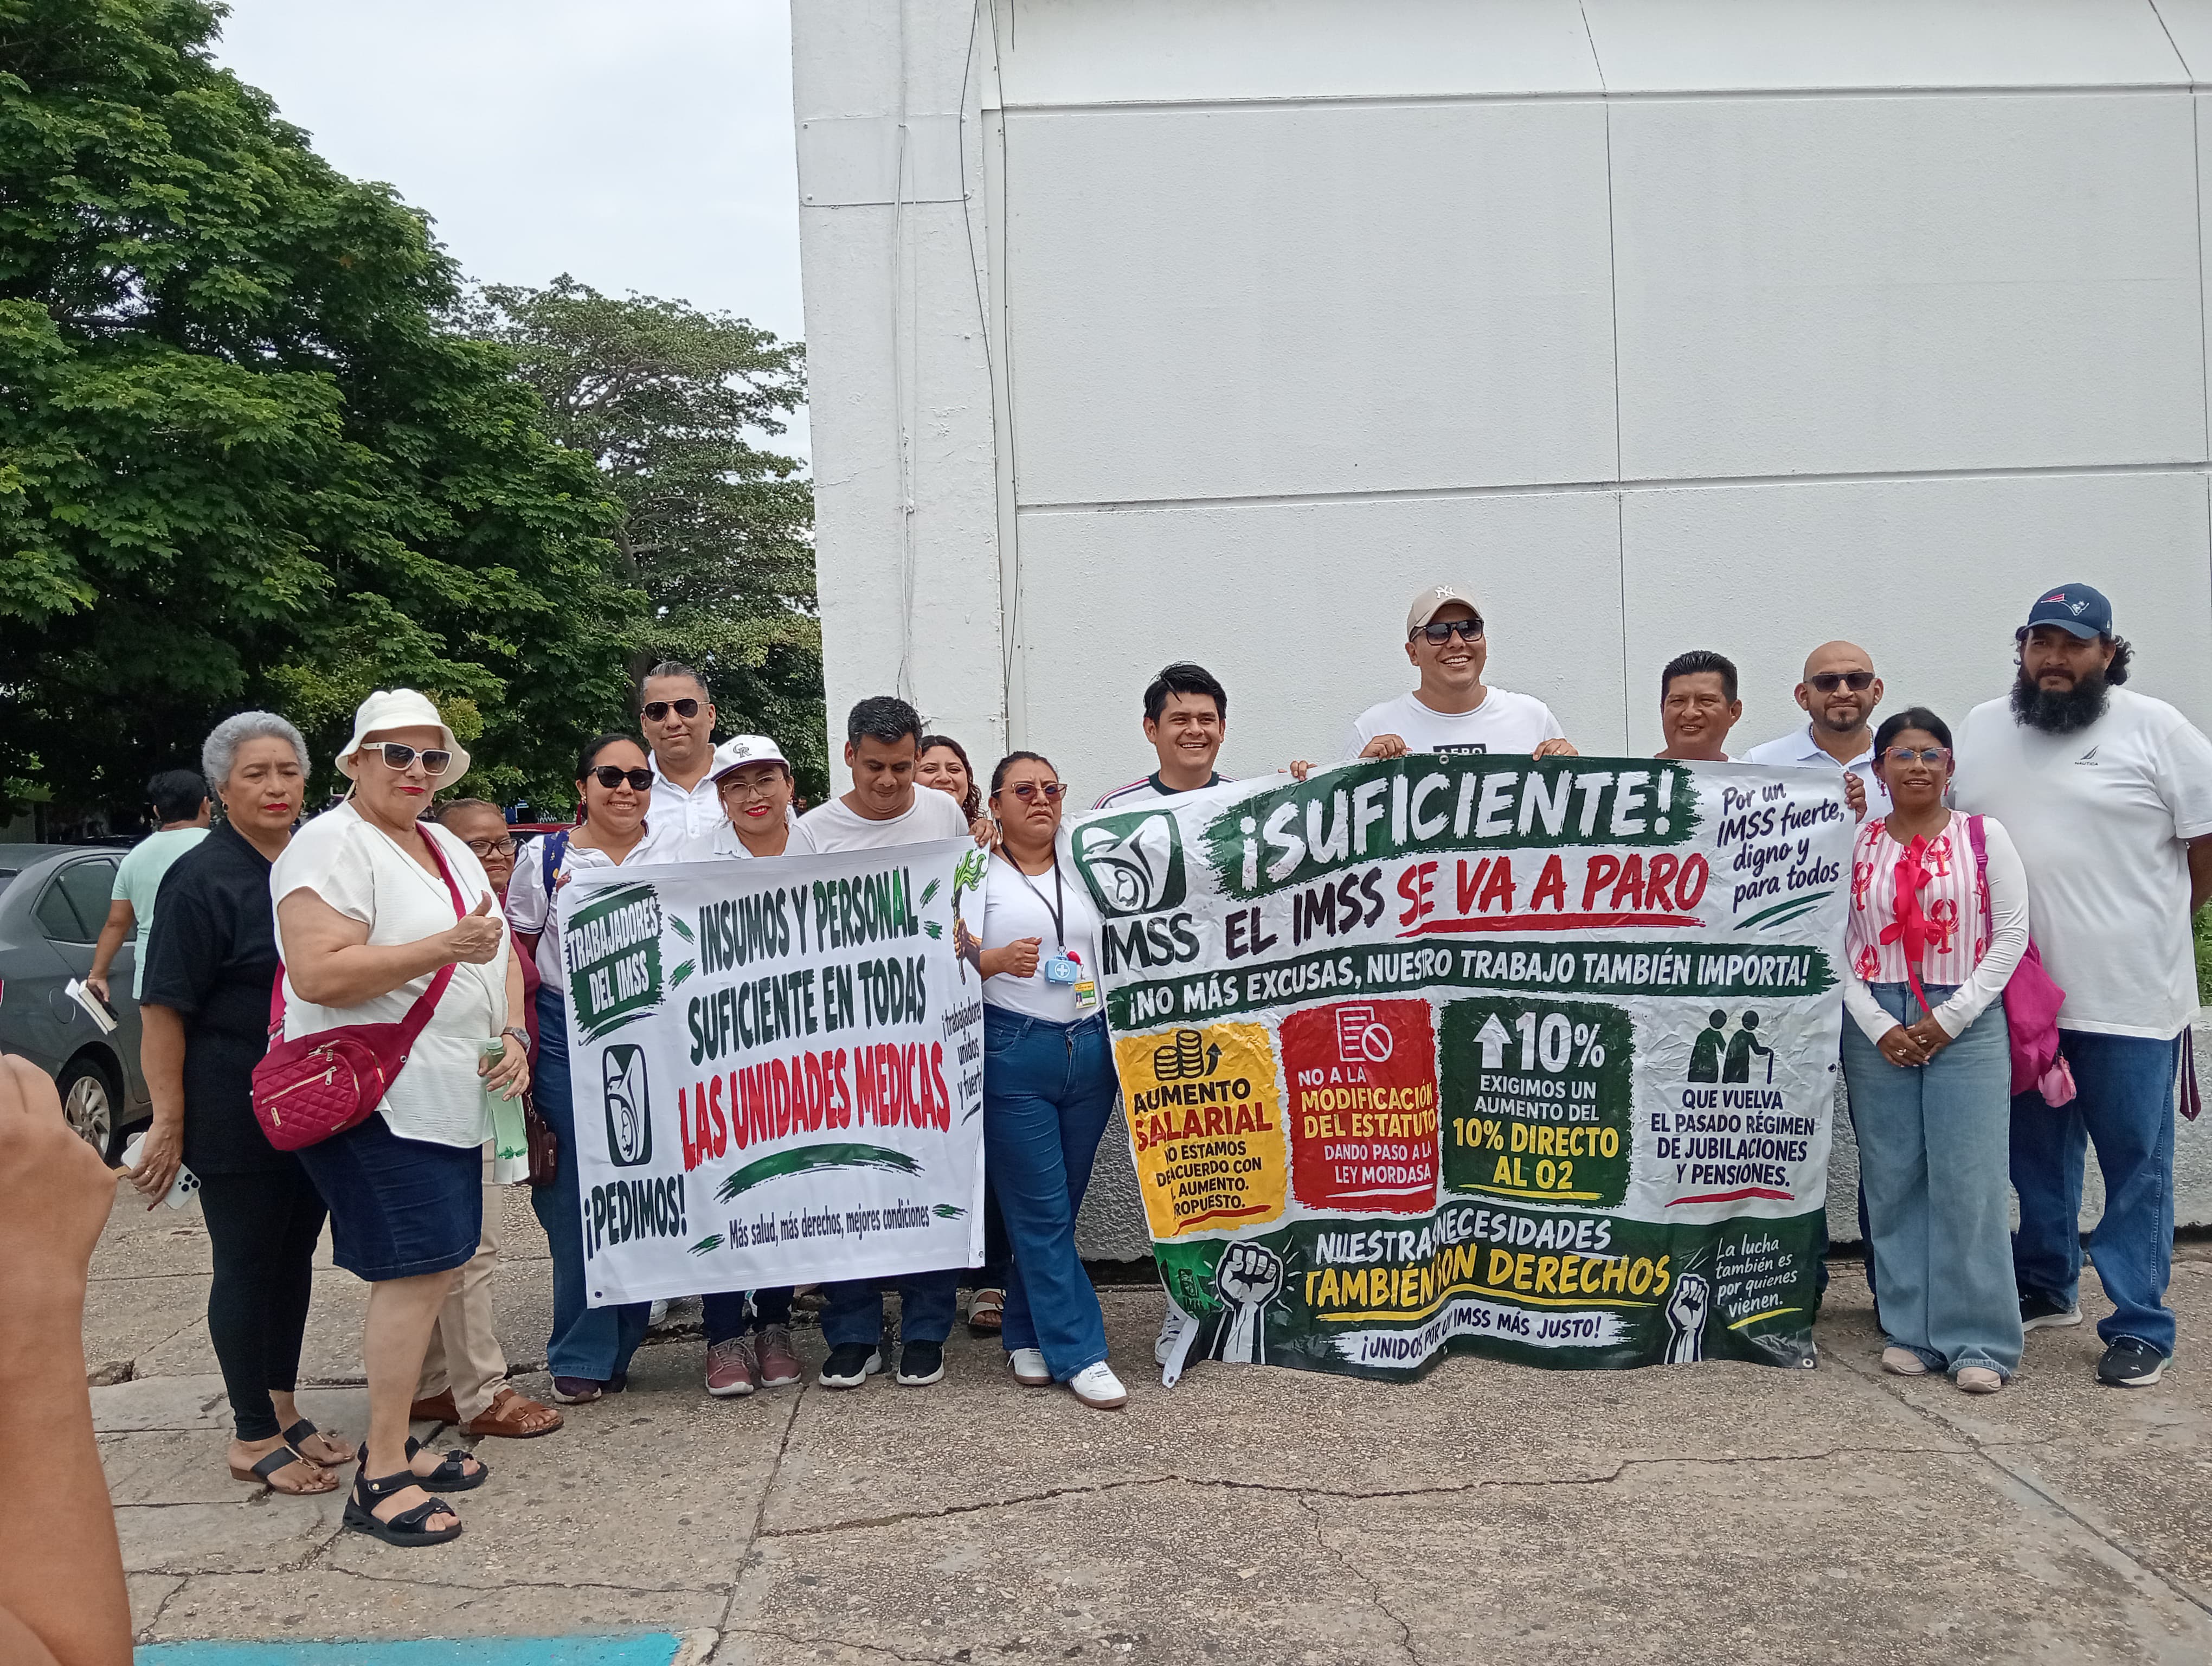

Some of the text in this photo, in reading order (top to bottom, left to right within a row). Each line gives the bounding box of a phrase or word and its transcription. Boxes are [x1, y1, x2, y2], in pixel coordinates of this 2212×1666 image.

[1722, 783, 1786, 816] Por un
[1239, 769, 1674, 892] ¡SUFICIENTE!
[1717, 798, 1845, 848] IMSS fuerte,
[1733, 838, 1810, 877] digno y
[1733, 856, 1840, 913] para todos
[699, 866, 919, 976] INSUMOS Y PERSONAL
[1226, 853, 1709, 960] EL IMSS SE VA A PARO
[567, 896, 658, 973] TRABAJADORES
[1102, 913, 1200, 975] IMSS
[589, 950, 650, 1015] DEL IMSS
[1130, 988, 1174, 1022] ¡NO
[1183, 972, 1239, 1013] MÁS
[1247, 958, 1362, 1002] EXCUSAS,
[1461, 950, 1576, 984] TRABAJO
[1583, 947, 1691, 985] TAMBIÉN
[1697, 954, 1811, 987] IMPORTA!
[687, 954, 926, 1066] SUFICIENTE EN TODAS
[957, 1029, 980, 1066] unidos
[1515, 1012, 1605, 1073] 10%
[1298, 1066, 1366, 1086] NO A LA
[1481, 1074, 1596, 1099] EXIGIMOS UN
[679, 1040, 950, 1172] LAS UNIDADES MEDICAS
[957, 1081, 964, 1110] y
[1134, 1078, 1251, 1115] AUMENTO
[1301, 1078, 1432, 1112] MODIFICACIÓN
[1474, 1096, 1599, 1122] AUMENTO DEL
[1682, 1090, 1783, 1110] QUE VUELVA
[1136, 1102, 1272, 1151] SALARIAL
[1304, 1108, 1436, 1138] DEL ESTATUTO
[1453, 1117, 1619, 1158] 10% DIRECTO
[1651, 1111, 1815, 1136] EL PASADO RÉGIMEN
[1181, 1141, 1246, 1159] ESTAMOS
[1324, 1140, 1432, 1161] DANDO PASO A LA
[1657, 1137, 1808, 1162] DE JUBILACIONES
[1170, 1160, 1230, 1181] ACUERDO
[1233, 1157, 1262, 1174] CON
[1179, 1177, 1249, 1197] AUMENTO.
[1335, 1163, 1431, 1184] LEY MORDASA
[1493, 1156, 1527, 1187] AL
[1676, 1163, 1790, 1187] Y PENSIONES.
[584, 1174, 687, 1261] ¡PEDIMOS!
[729, 1199, 930, 1250] Más salud, más derechos, mejores condiciones
[1174, 1195, 1245, 1220] ROPUESTO.
[1437, 1207, 1611, 1251] NECESIDADES
[1716, 1233, 1779, 1261] La lucha
[1306, 1262, 1435, 1307] TAMBIÉN
[1488, 1249, 1670, 1296] DERECHOS
[1716, 1254, 1793, 1279] también es
[1717, 1270, 1798, 1305] por quienes
[1728, 1293, 1783, 1317] vienen.
[1361, 1332, 1423, 1361] ¡UNIDOS
[1425, 1322, 1441, 1350] POR
[1454, 1307, 1490, 1328] IMSS
[1497, 1310, 1530, 1335] MÁS
[1538, 1316, 1601, 1339] JUSTO!
